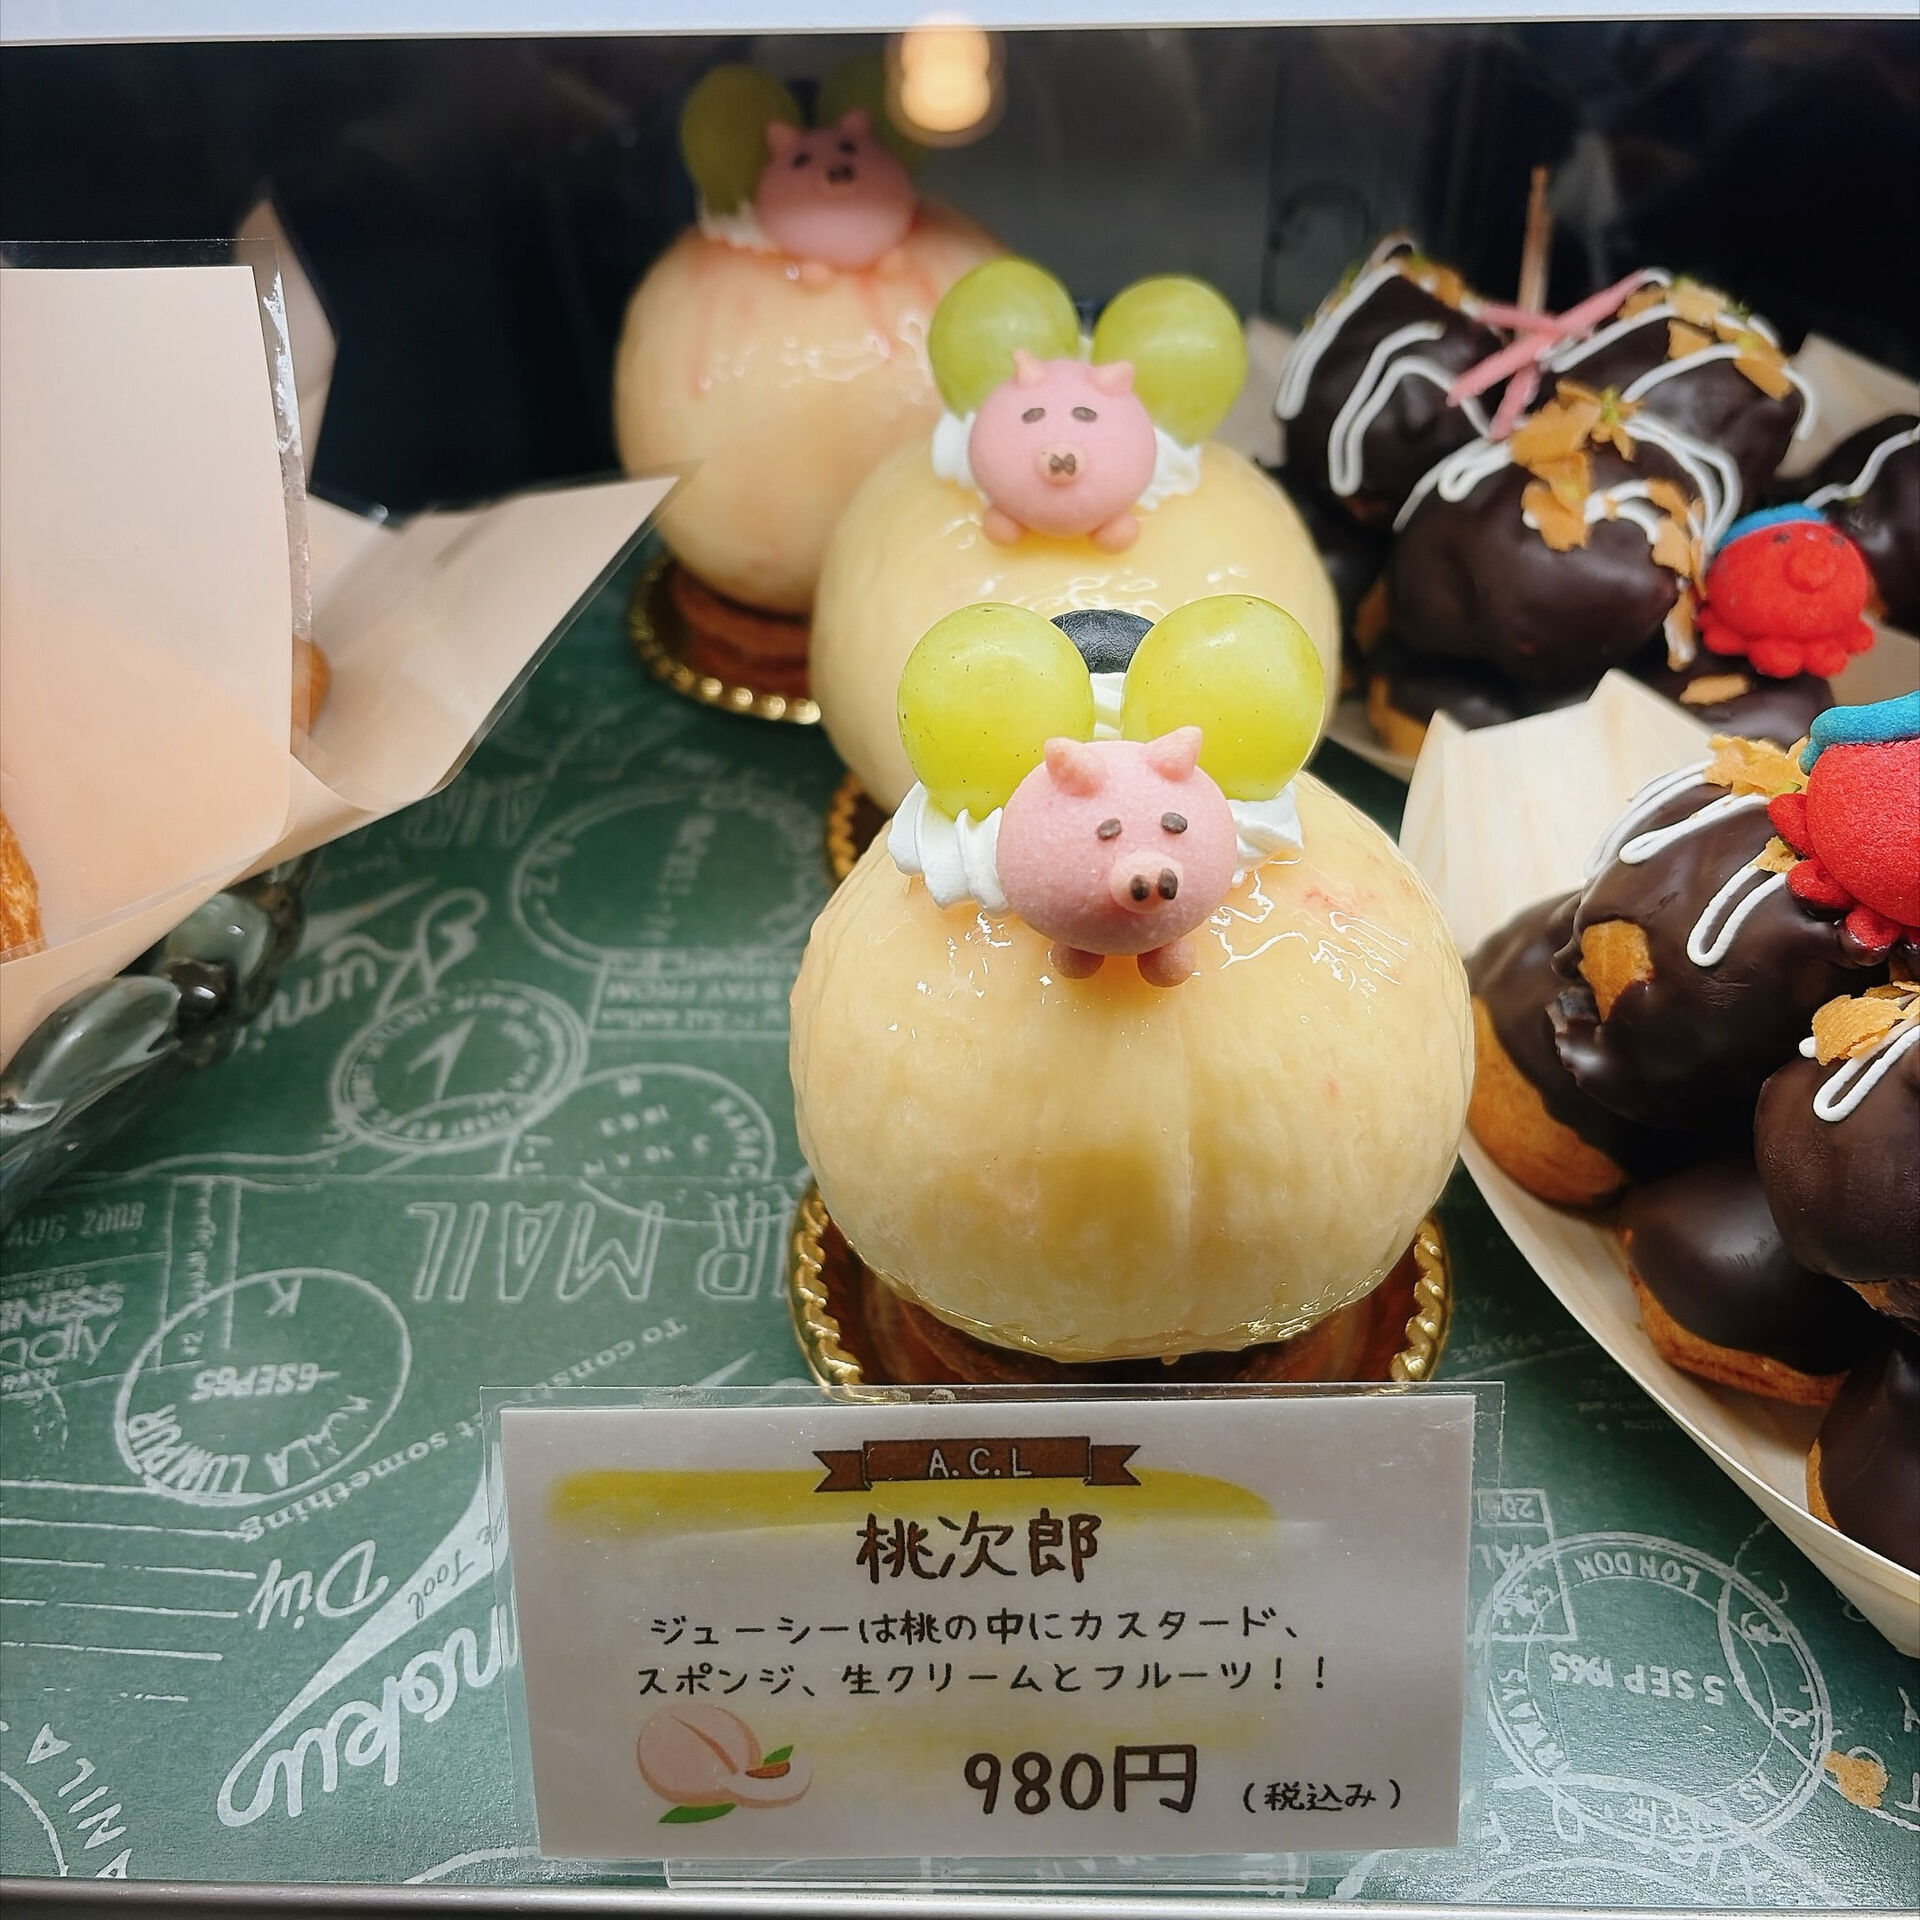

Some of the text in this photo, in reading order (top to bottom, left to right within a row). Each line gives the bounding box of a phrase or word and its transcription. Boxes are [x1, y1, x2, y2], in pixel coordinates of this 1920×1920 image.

[405, 1200, 665, 1302] MAIL
[238, 1430, 448, 1543] something
[928, 1447, 1032, 1479] A.C.L
[855, 1507, 1102, 1584] 桃次郎
[1573, 1551, 1700, 1593] LONDON
[248, 1539, 389, 1630] Diy
[407, 1547, 475, 1620] Tool
[650, 1606, 1297, 1646] ジューシーは桃の中にカスタード、
[1549, 1651, 1727, 1705] 5 SEP 1965
[963, 1744, 1401, 1815] 980円 （税込み）
